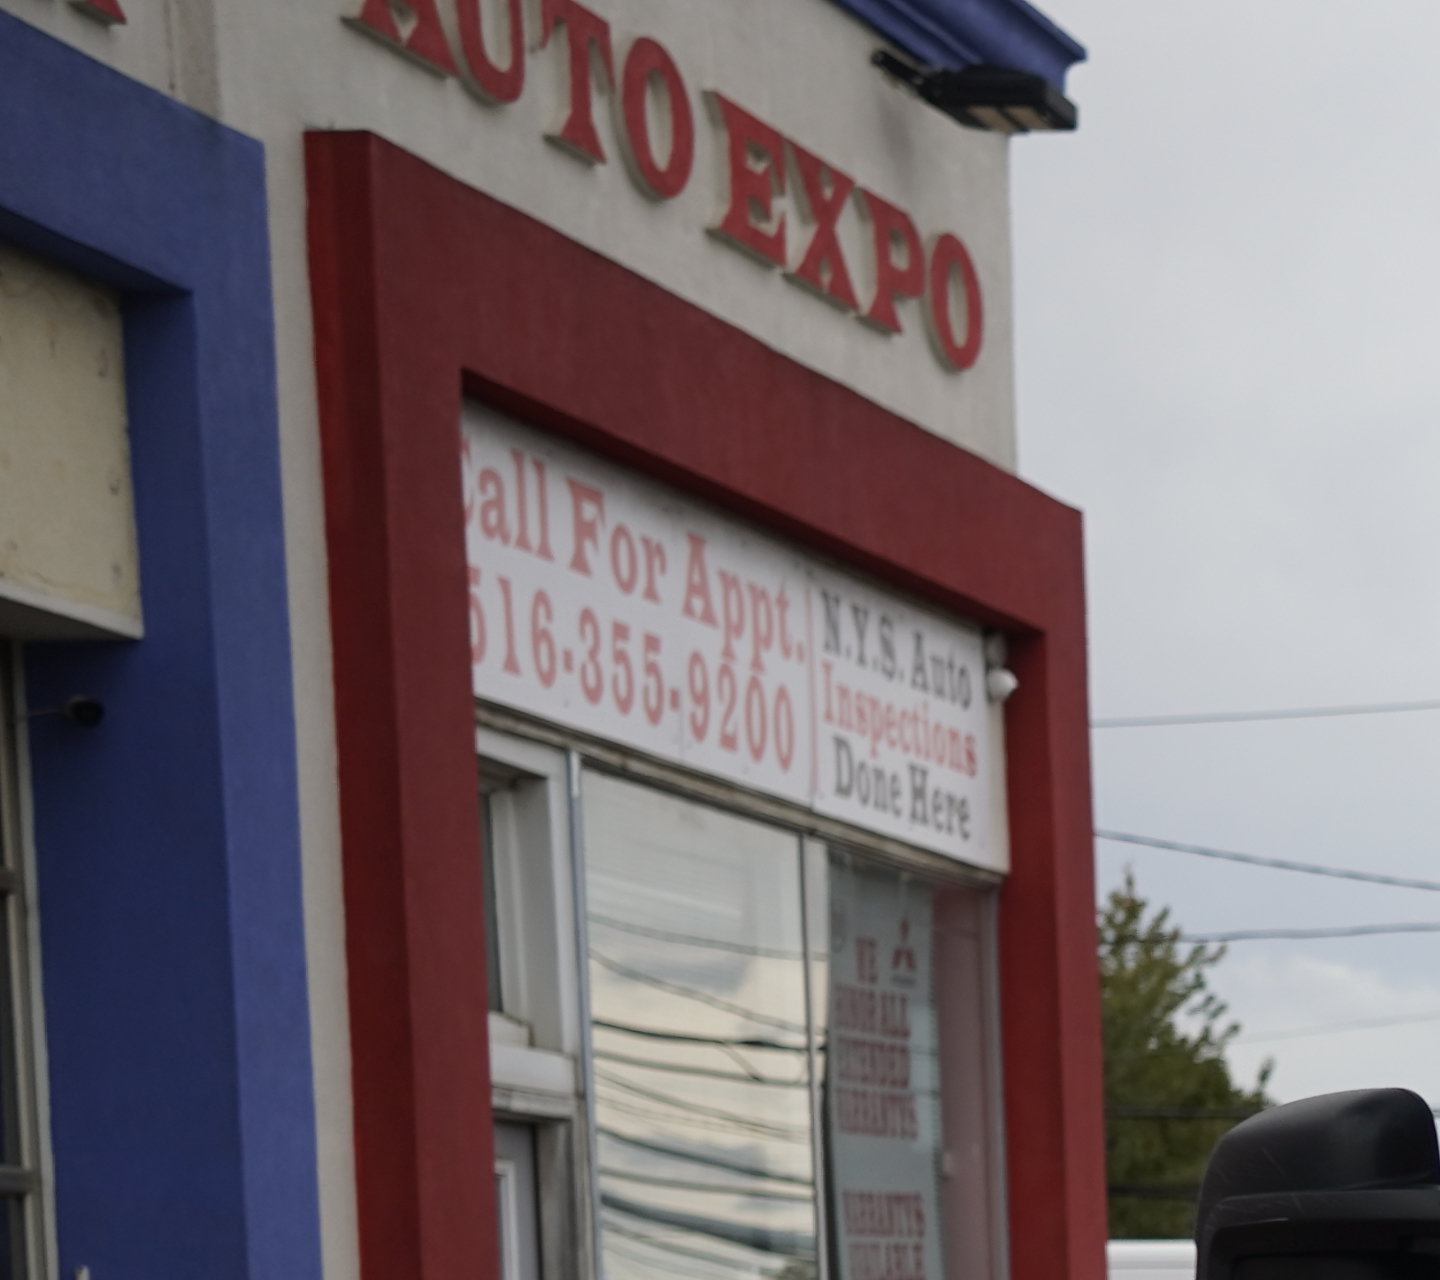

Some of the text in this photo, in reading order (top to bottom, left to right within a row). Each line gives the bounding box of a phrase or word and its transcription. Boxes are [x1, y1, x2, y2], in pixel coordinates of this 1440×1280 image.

[700, 88, 983, 371] EXPO
[566, 474, 667, 606] For
[682, 531, 804, 674] Appt.
[821, 660, 978, 779] Inspections
[911, 630, 973, 711] Auto
[832, 734, 971, 842] Done Here
